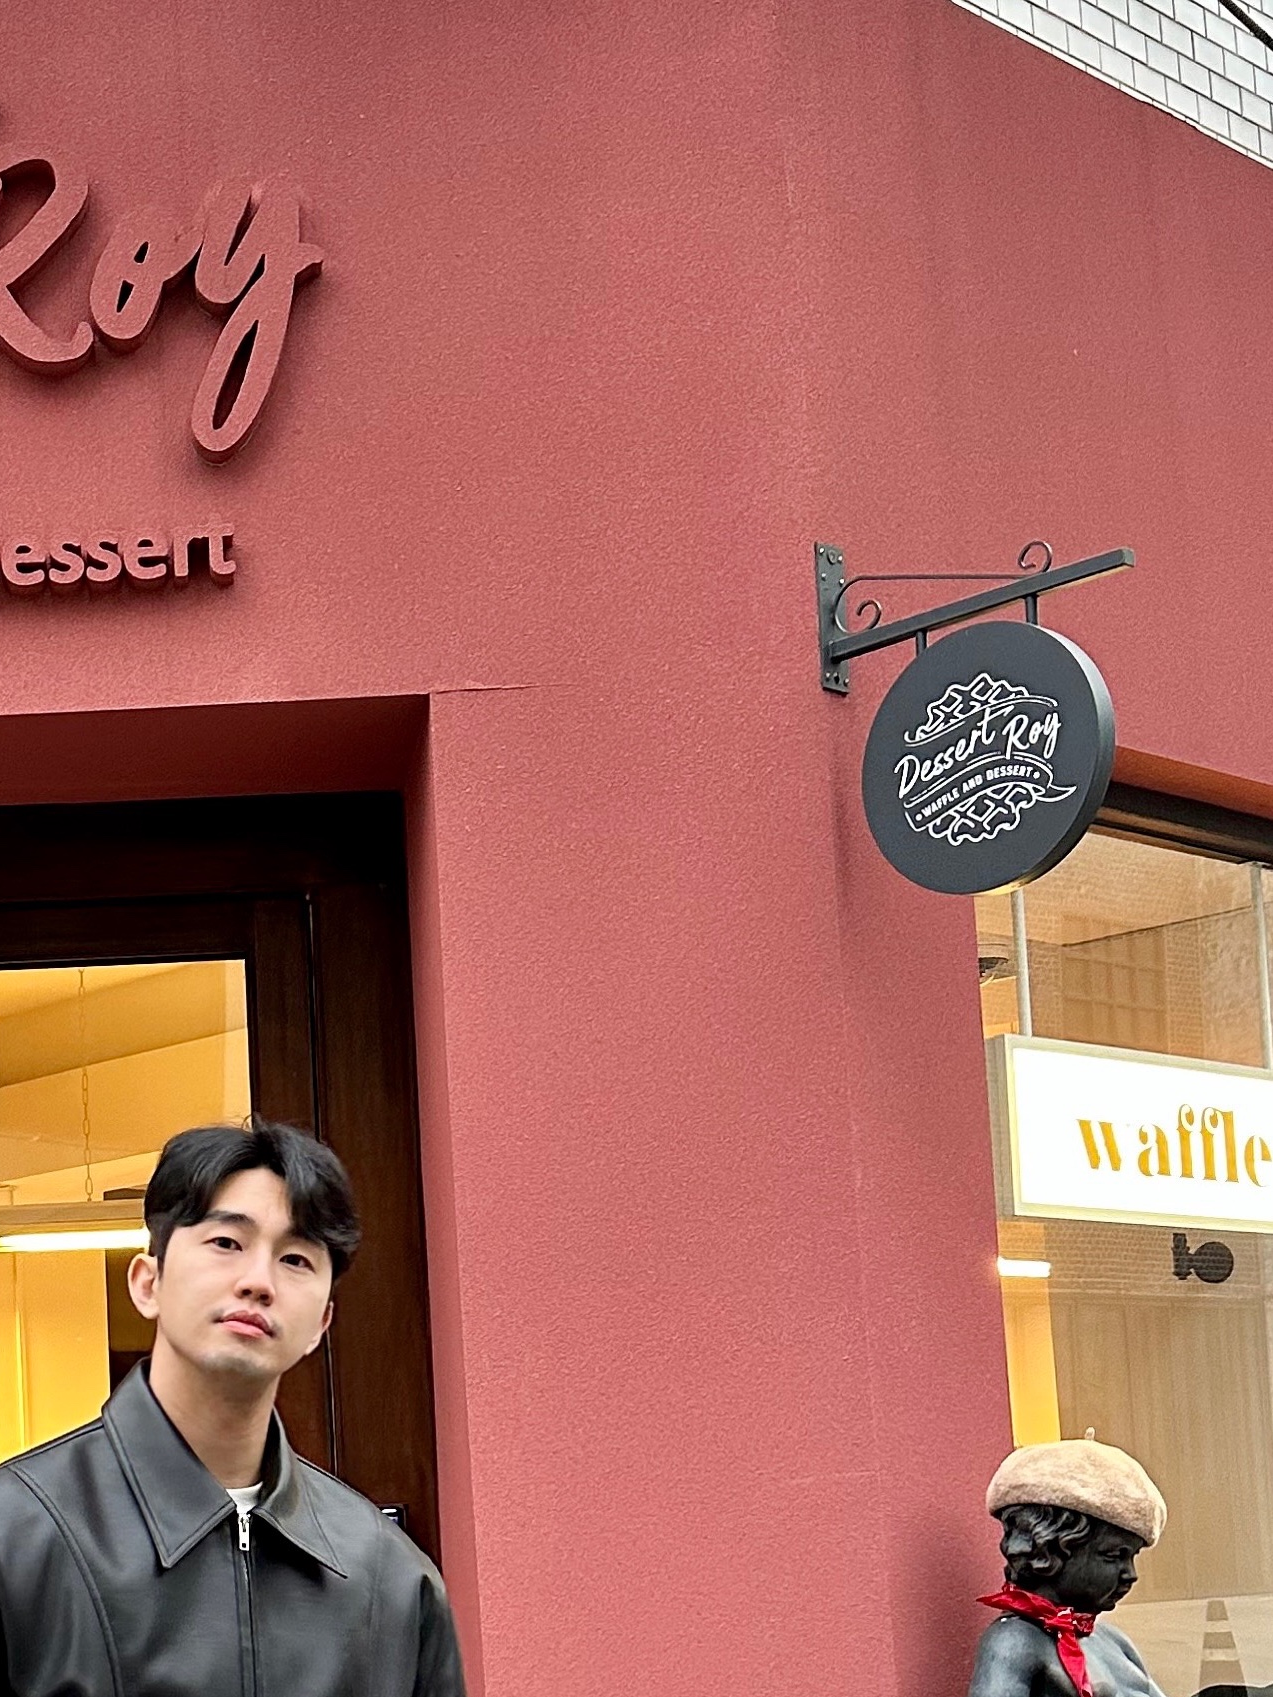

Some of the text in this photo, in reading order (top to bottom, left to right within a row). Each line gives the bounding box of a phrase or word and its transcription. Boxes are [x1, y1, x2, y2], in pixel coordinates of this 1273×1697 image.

[894, 704, 1062, 799] Dessert Roy
[921, 764, 1034, 817] WAFFLE AND DESSERT
[1075, 1102, 1273, 1188] waffle
